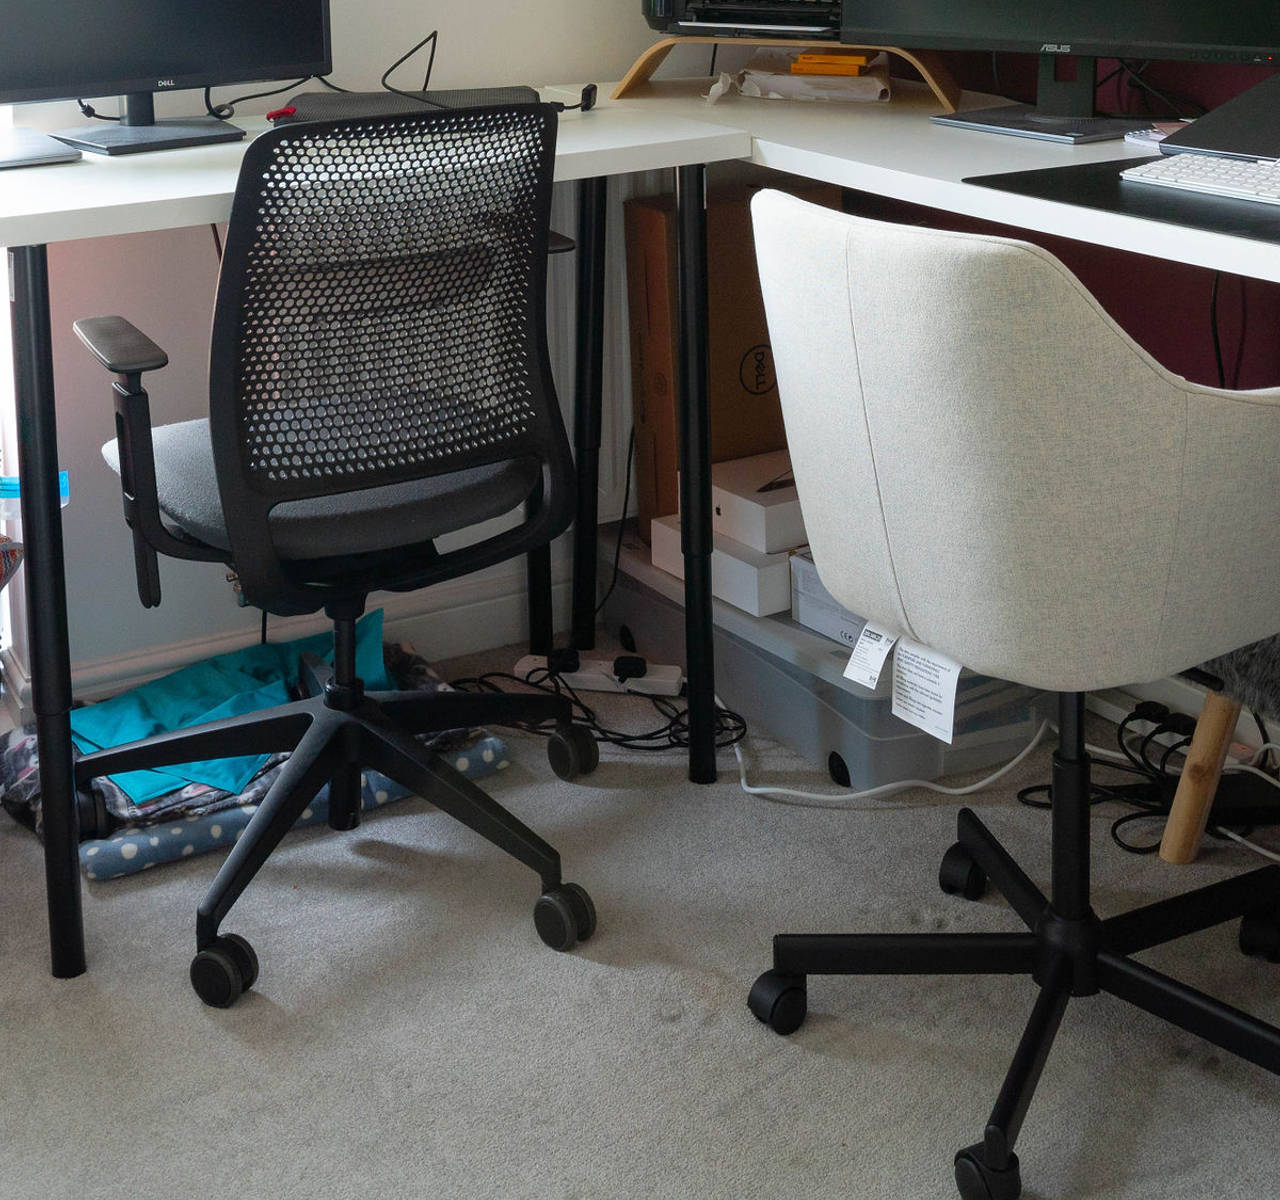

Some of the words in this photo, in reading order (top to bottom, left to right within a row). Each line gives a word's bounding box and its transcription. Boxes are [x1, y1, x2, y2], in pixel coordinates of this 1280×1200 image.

[1039, 44, 1071, 53] ASUS
[158, 79, 175, 87] DELL
[755, 352, 766, 390] DELL
